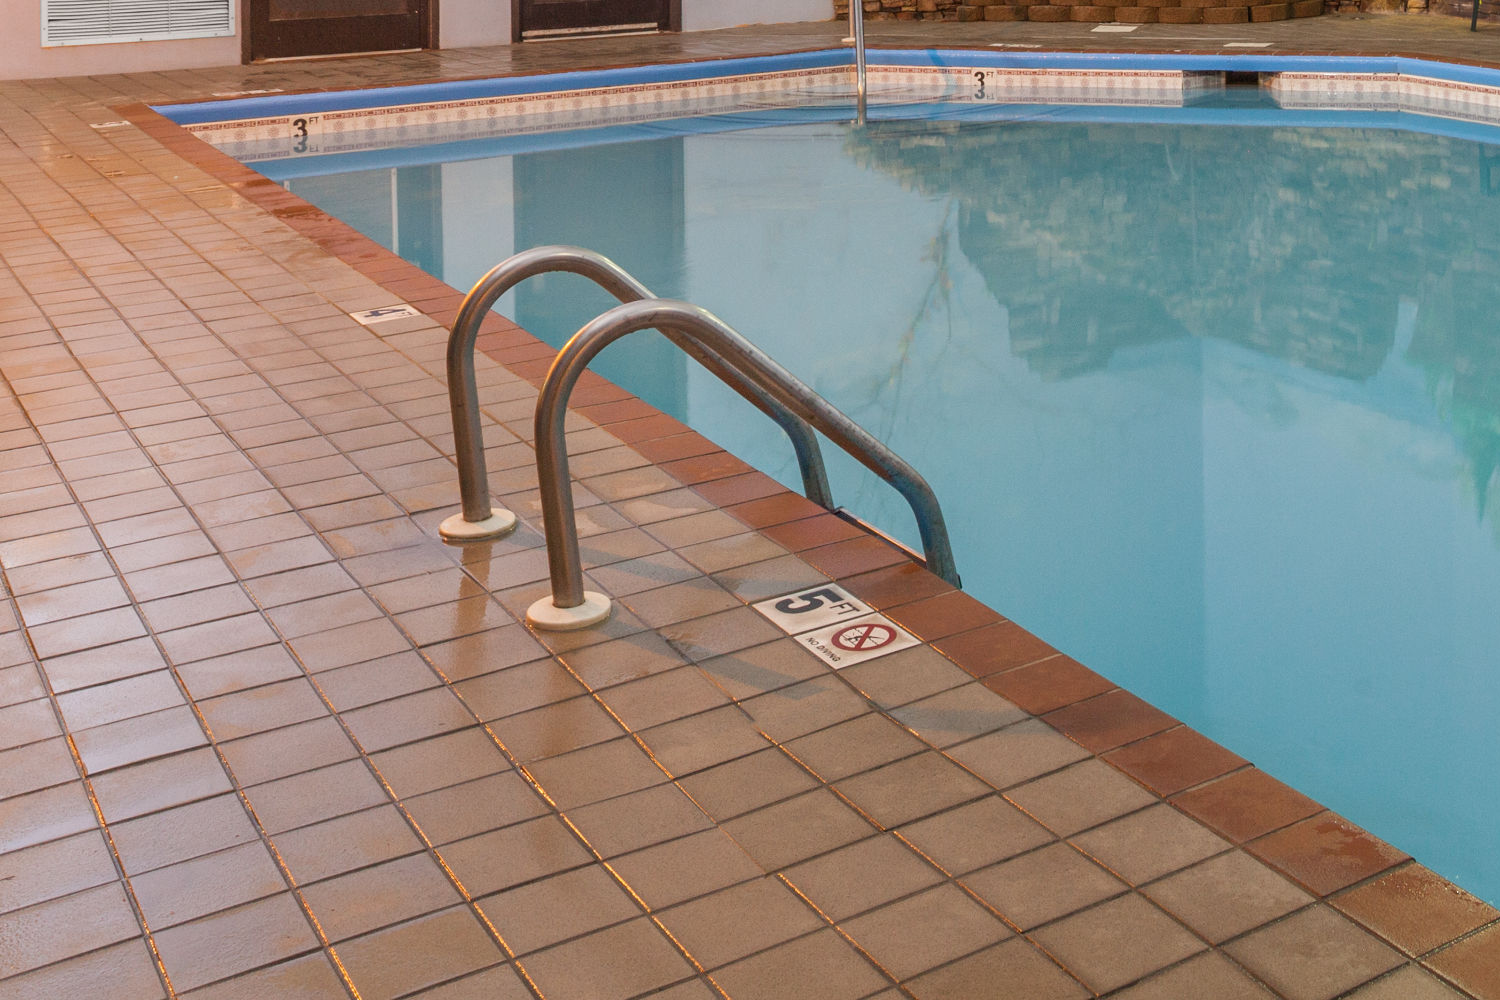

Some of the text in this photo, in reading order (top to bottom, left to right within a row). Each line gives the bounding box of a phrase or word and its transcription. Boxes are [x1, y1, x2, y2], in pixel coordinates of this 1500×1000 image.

[974, 71, 985, 87] 3
[293, 116, 319, 137] 3 FT
[775, 588, 860, 615] 5 FT
[806, 637, 841, 662] NO DIVING
